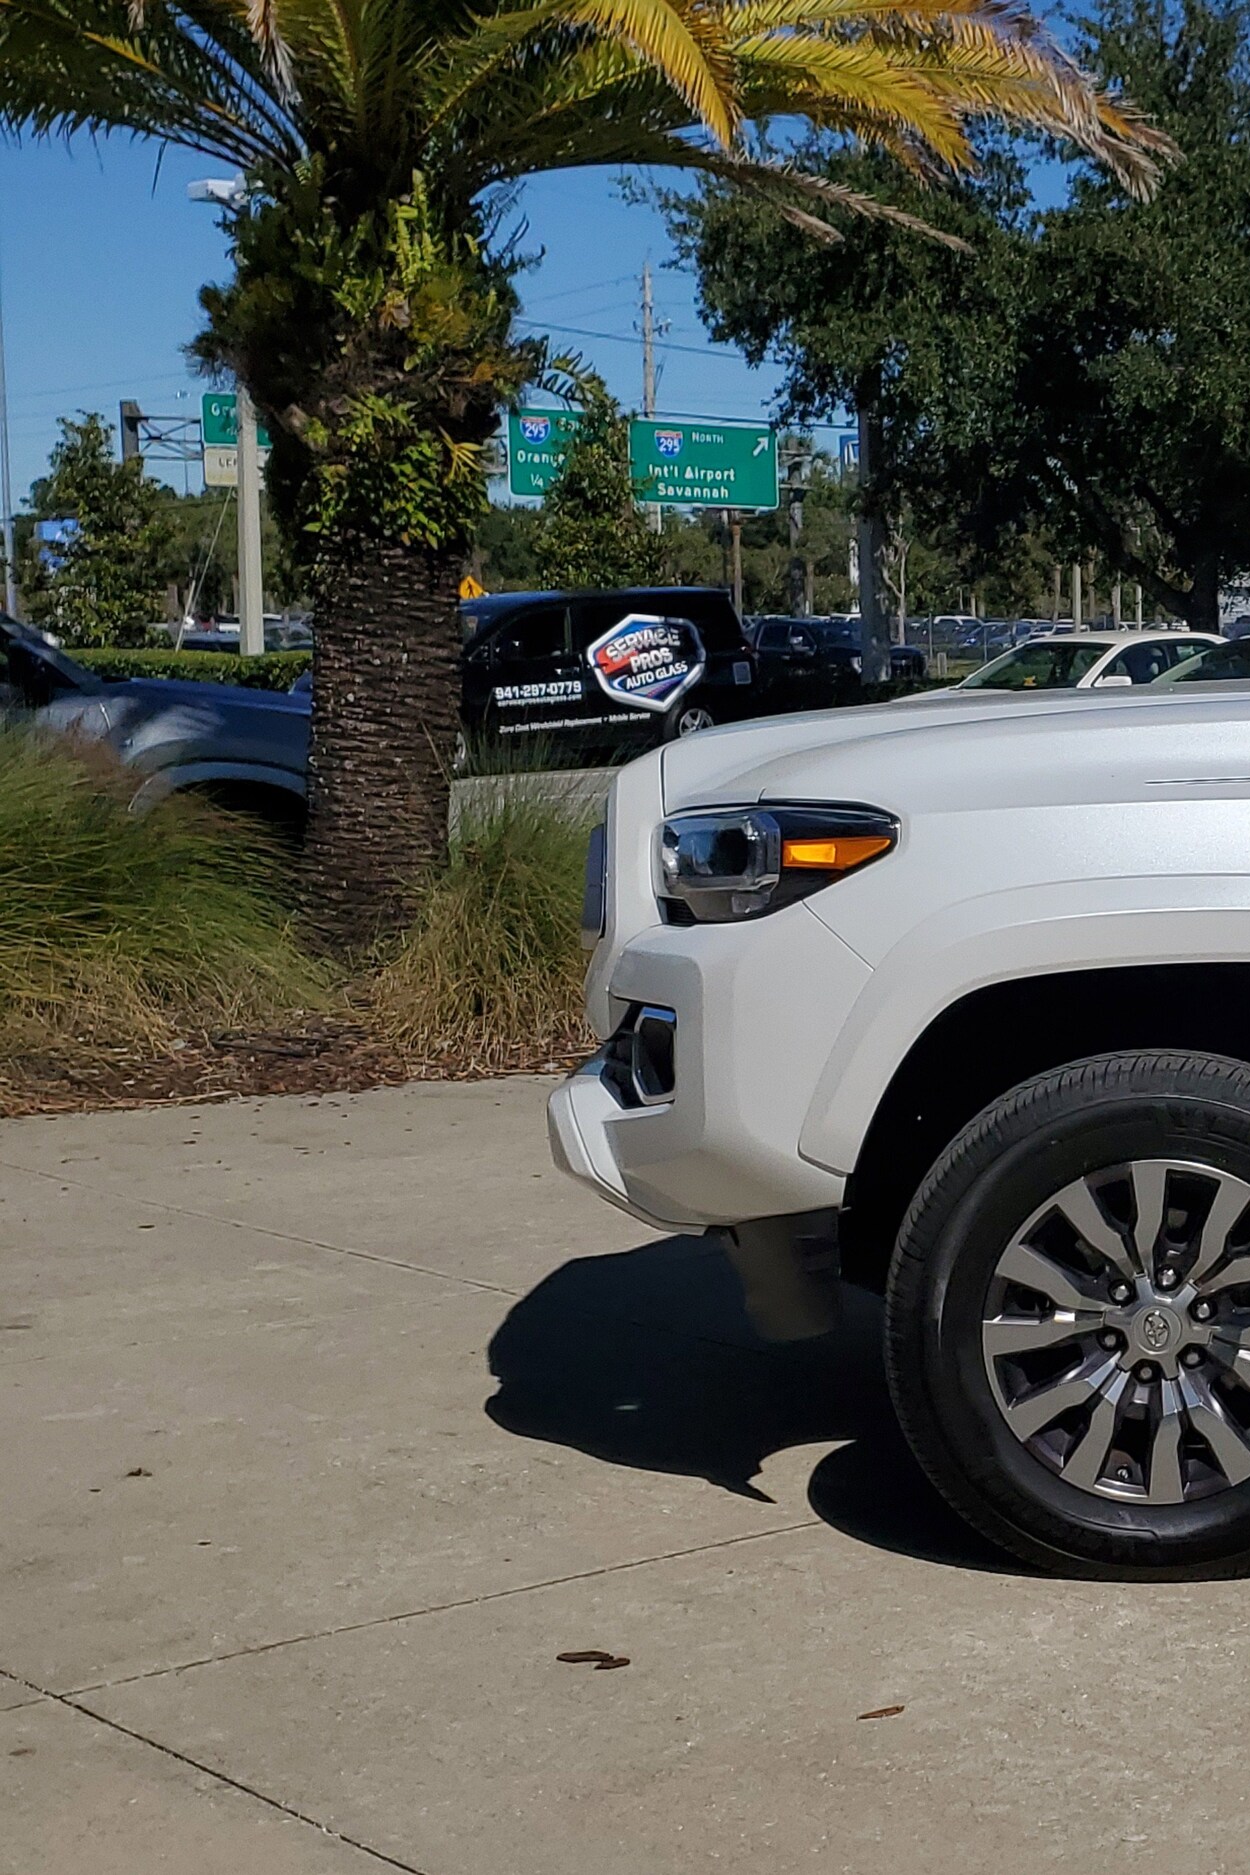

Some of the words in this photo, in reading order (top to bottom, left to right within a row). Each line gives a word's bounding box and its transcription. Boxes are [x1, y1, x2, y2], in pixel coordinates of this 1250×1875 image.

[525, 422, 546, 438] 295
[659, 437, 680, 452] 295
[692, 431, 724, 444] NORTH
[649, 463, 679, 478] Int'l
[684, 466, 735, 483] Airport
[657, 482, 729, 499] Savannah
[606, 627, 680, 661] SERVICE
[630, 647, 673, 673] PROS
[626, 671, 654, 690] AUTO
[655, 660, 688, 681] GLASS
